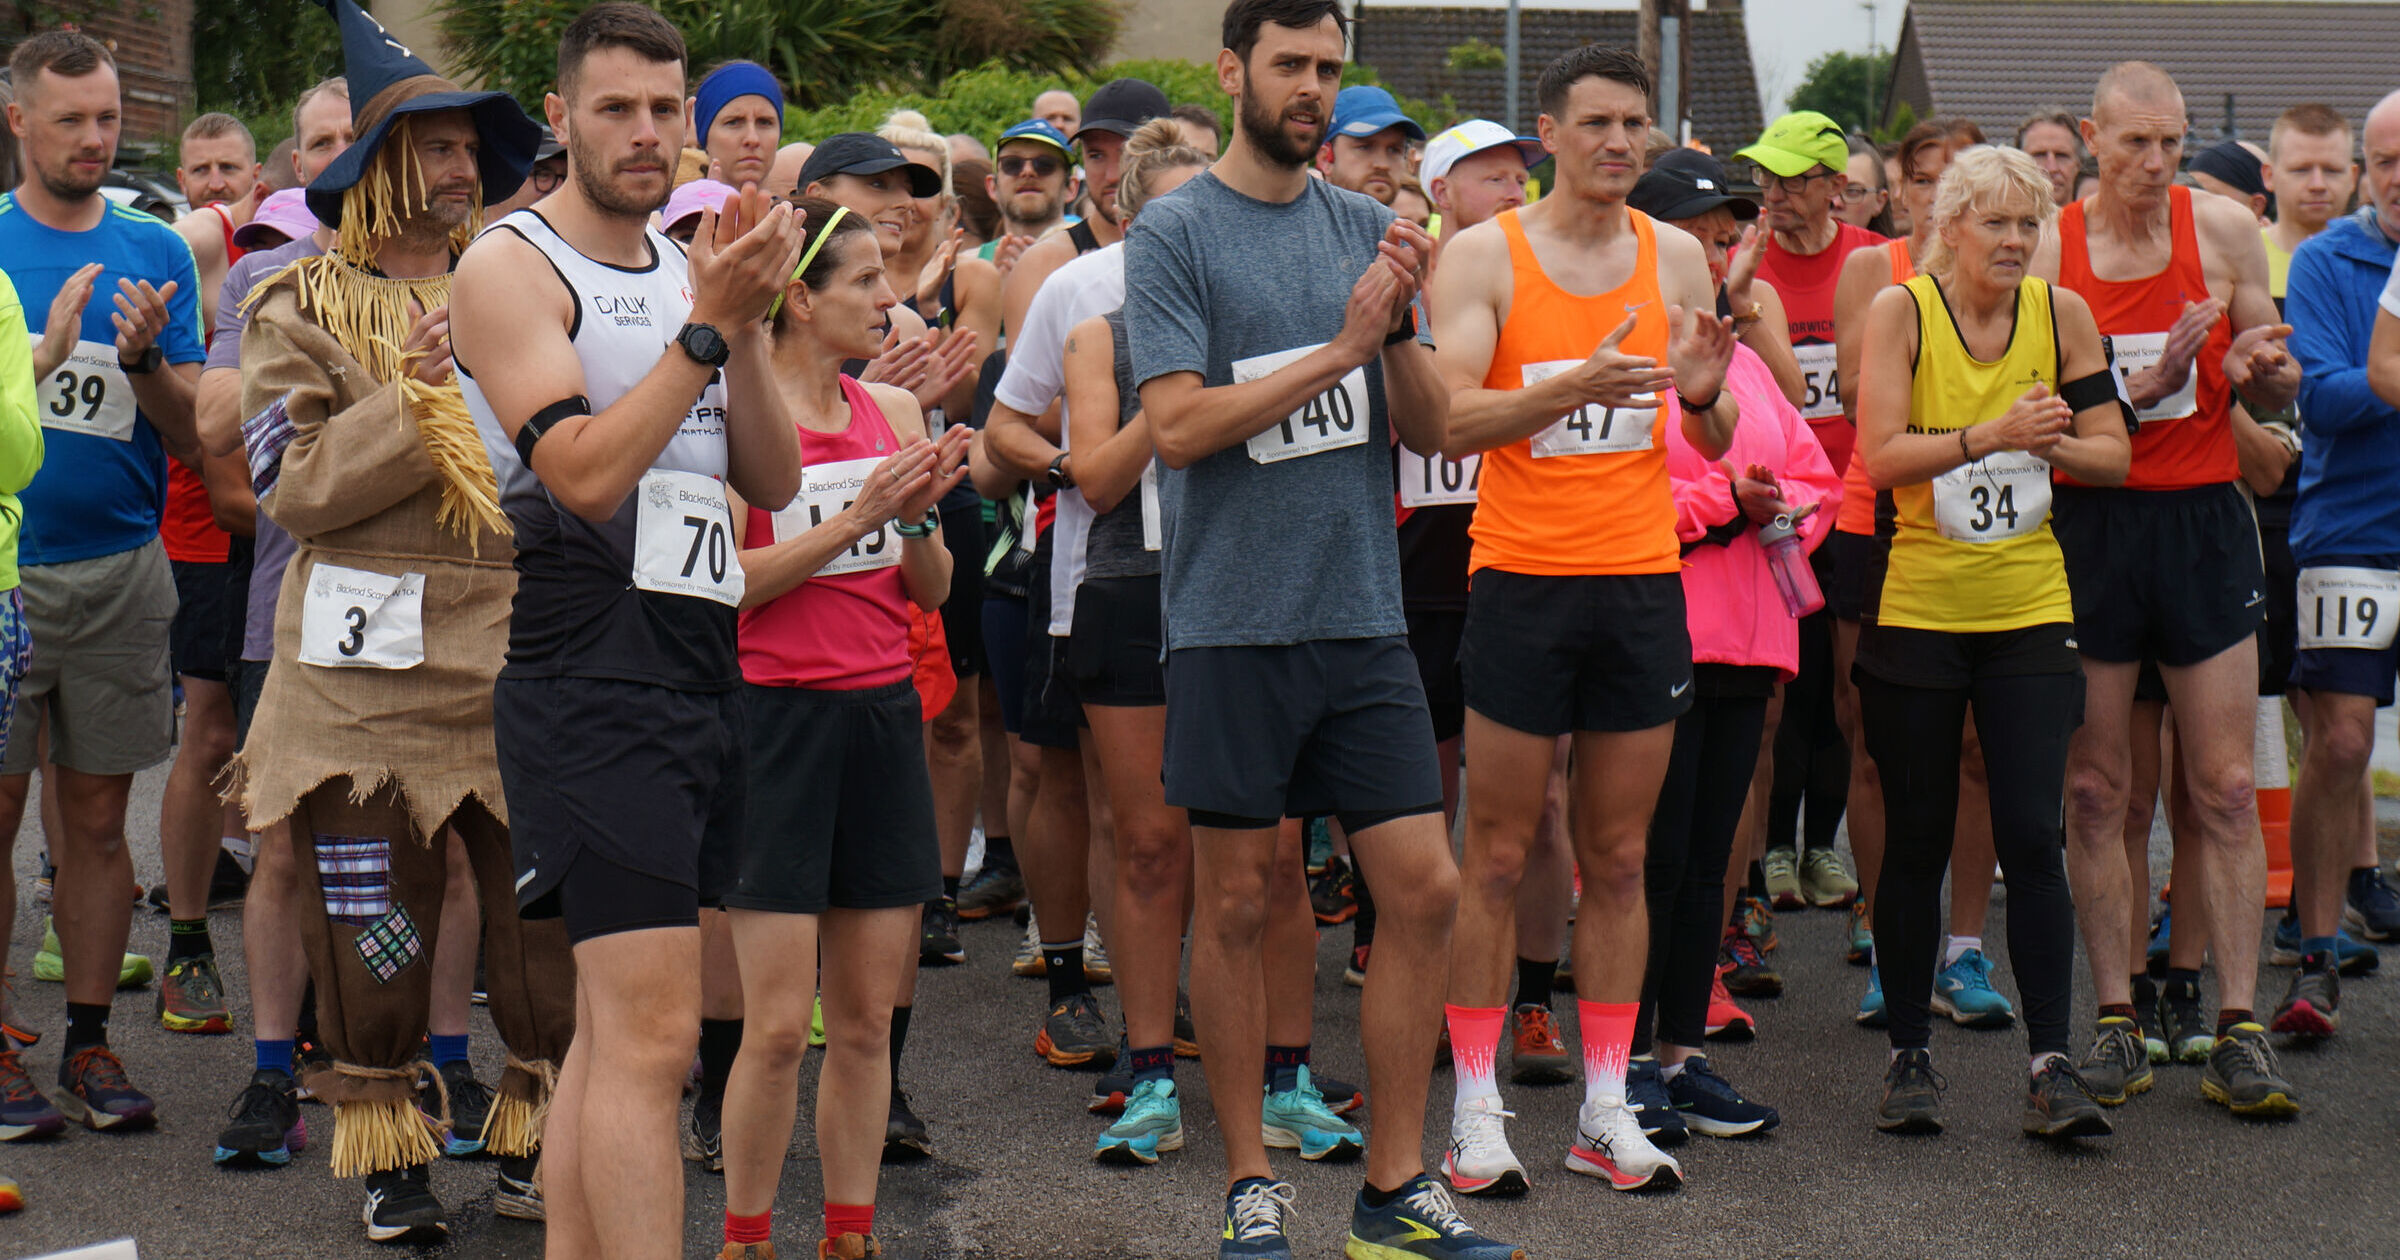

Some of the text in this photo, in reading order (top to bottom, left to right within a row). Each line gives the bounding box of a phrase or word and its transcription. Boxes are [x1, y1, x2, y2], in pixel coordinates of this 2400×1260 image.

[614, 315, 652, 327] SERVICES
[1788, 320, 1835, 334] ORWICH
[50, 370, 106, 421] 39
[1805, 370, 1841, 408] 54
[679, 489, 711, 506] Blackrod
[808, 477, 847, 492] Blackrod
[1969, 484, 2018, 532] 34
[680, 515, 727, 584] 70
[336, 583, 366, 597] Blackrod
[649, 577, 696, 592] Sponsored by
[2315, 596, 2379, 637] 119
[338, 605, 367, 657] 3
